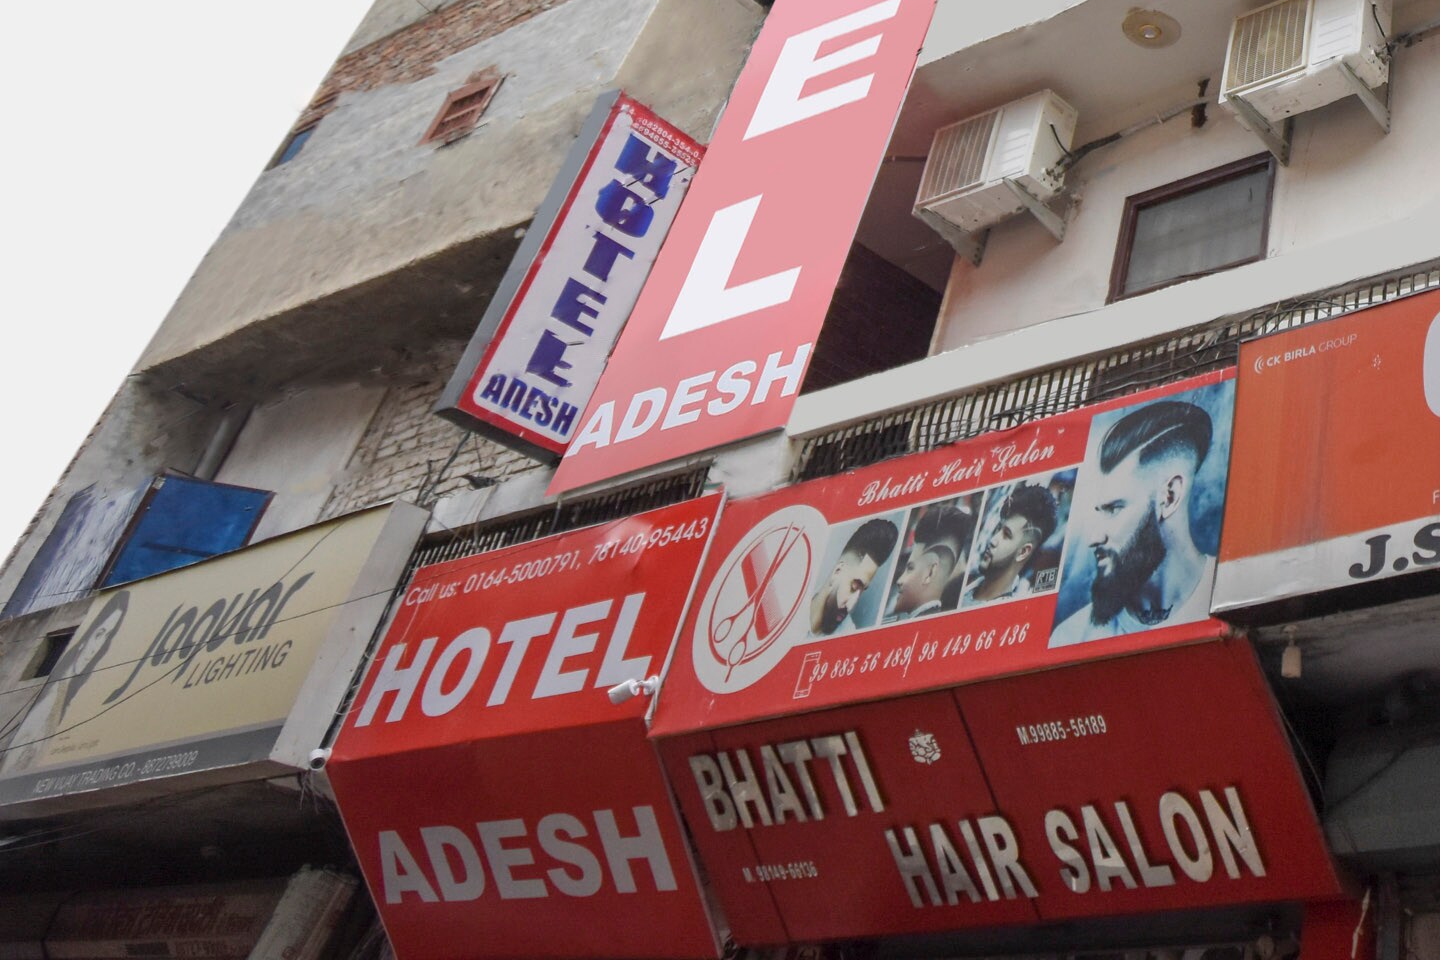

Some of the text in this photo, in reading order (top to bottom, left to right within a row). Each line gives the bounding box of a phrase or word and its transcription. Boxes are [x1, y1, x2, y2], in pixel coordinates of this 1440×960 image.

[1266, 333, 1358, 367] CK BIRLA GROUP
[557, 343, 813, 459] ADESH
[857, 472, 929, 507] Bhatti
[933, 457, 986, 487] Hair
[405, 588, 440, 607] Call
[440, 581, 462, 598] us:
[183, 639, 293, 689] LIGHTING
[354, 593, 654, 728] HOTEL
[809, 663, 828, 683] 99
[860, 651, 881, 673] 56
[918, 641, 939, 662] 98
[975, 630, 996, 651] 66
[999, 623, 1030, 647] 136
[76, 766, 118, 787] TRADING
[689, 729, 885, 832] BHATTI
[379, 805, 678, 905] ADESH
[884, 785, 1266, 909] HAIR SALON
